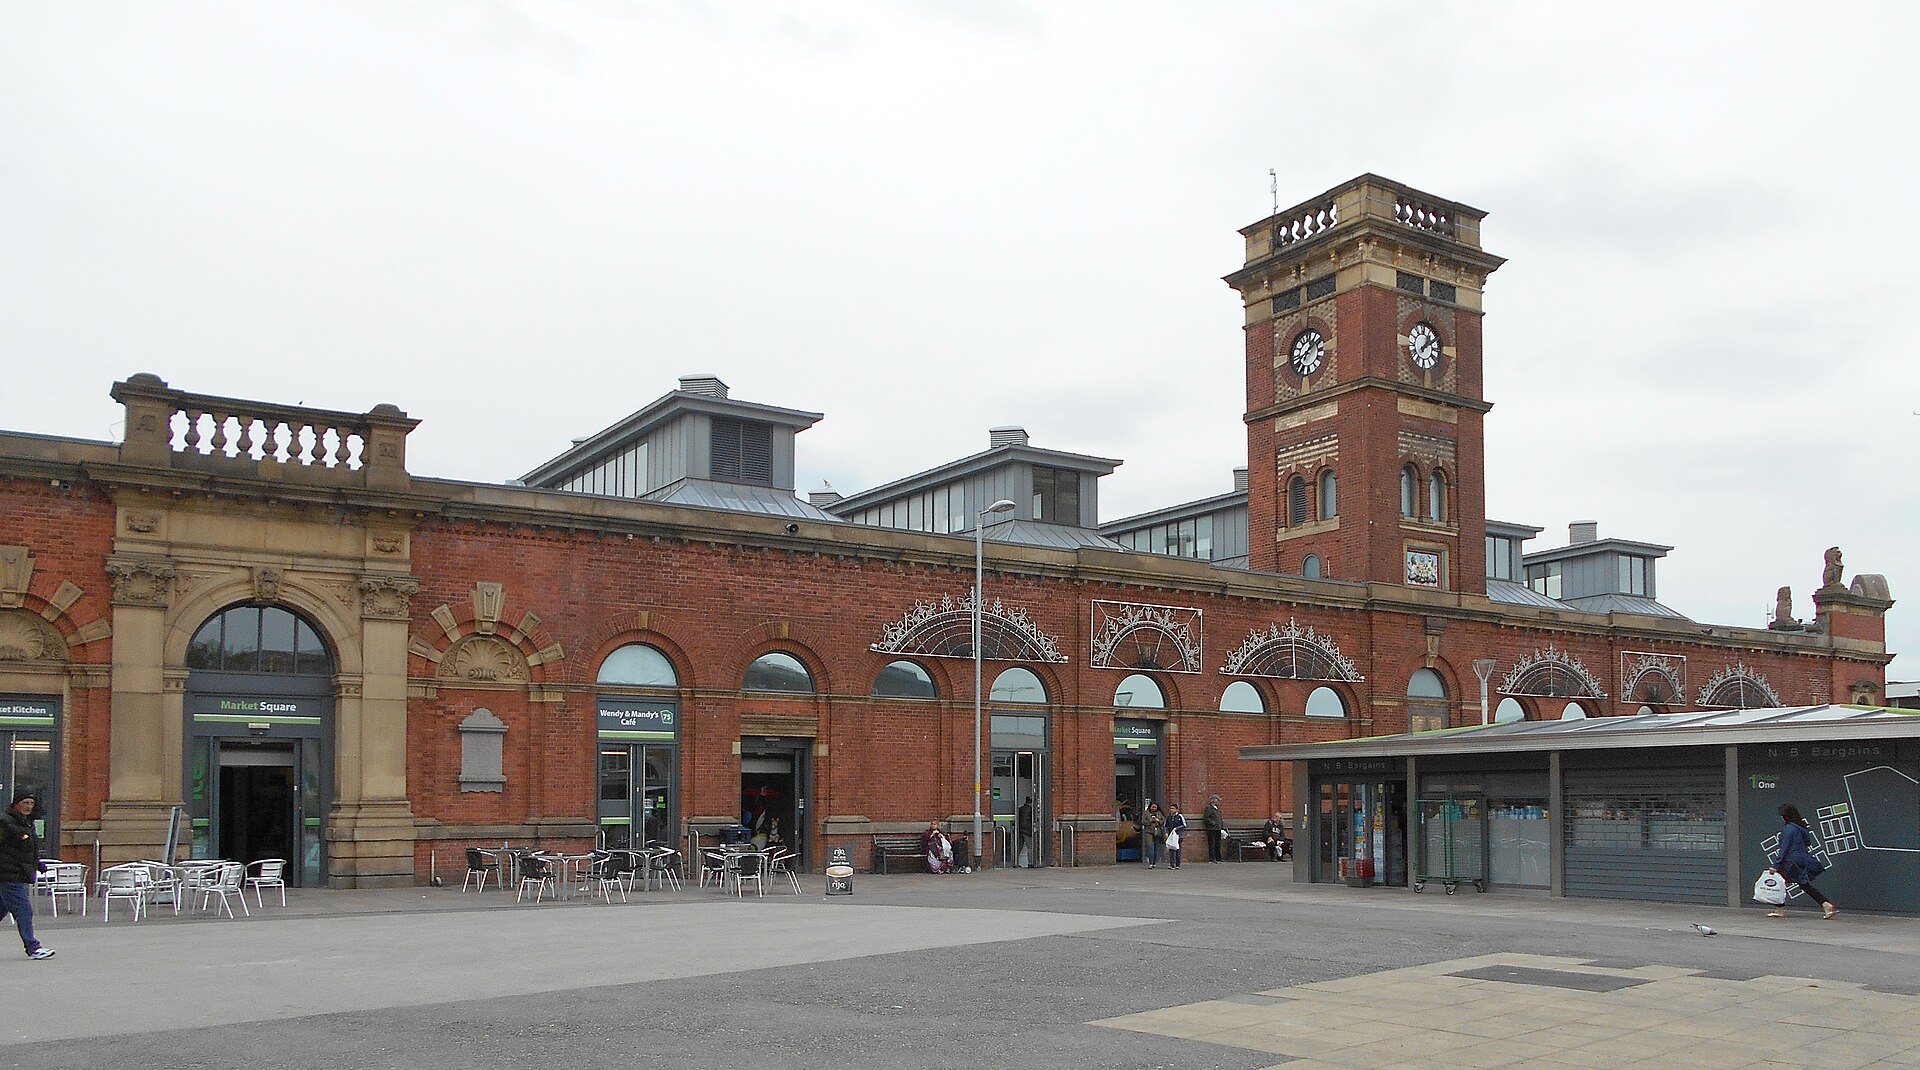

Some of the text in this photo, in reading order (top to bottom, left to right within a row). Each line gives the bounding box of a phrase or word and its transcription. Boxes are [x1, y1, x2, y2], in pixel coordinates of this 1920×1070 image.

[12, 705, 47, 714] Kitchen
[221, 700, 297, 713] Market Square
[599, 709, 624, 718] Wendy
[631, 710, 659, 720] Mandy's
[662, 713, 671, 721] 75
[620, 718, 637, 726] Café
[1131, 726, 1151, 735] Square
[1767, 748, 1777, 757] N
[1812, 745, 1880, 758] Bargains
[1347, 761, 1386, 771] Bargains
[1758, 781, 1776, 789] One
